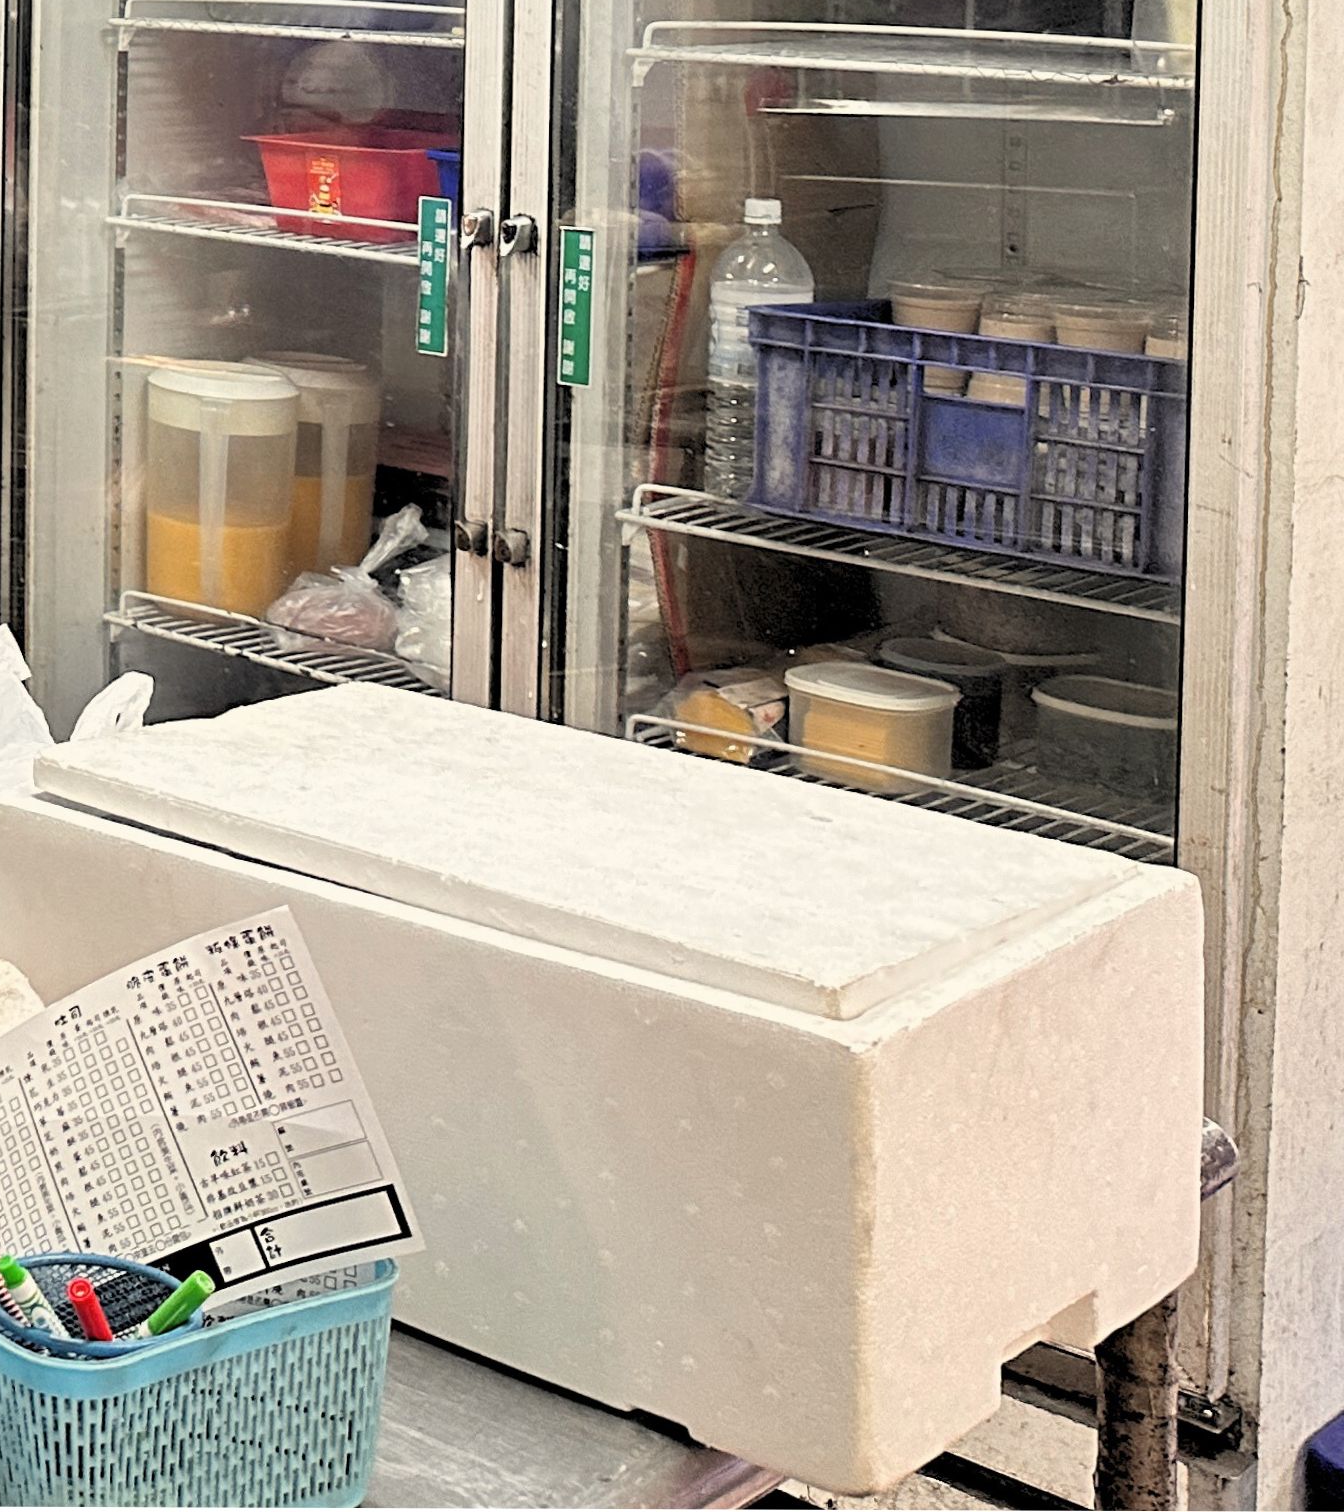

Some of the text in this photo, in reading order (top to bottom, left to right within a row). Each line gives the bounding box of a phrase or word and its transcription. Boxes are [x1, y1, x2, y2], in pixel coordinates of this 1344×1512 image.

[54, 1004, 82, 1027] 吐司
[210, 1141, 248, 1167] 飲料
[260, 1226, 283, 1260] 合計
